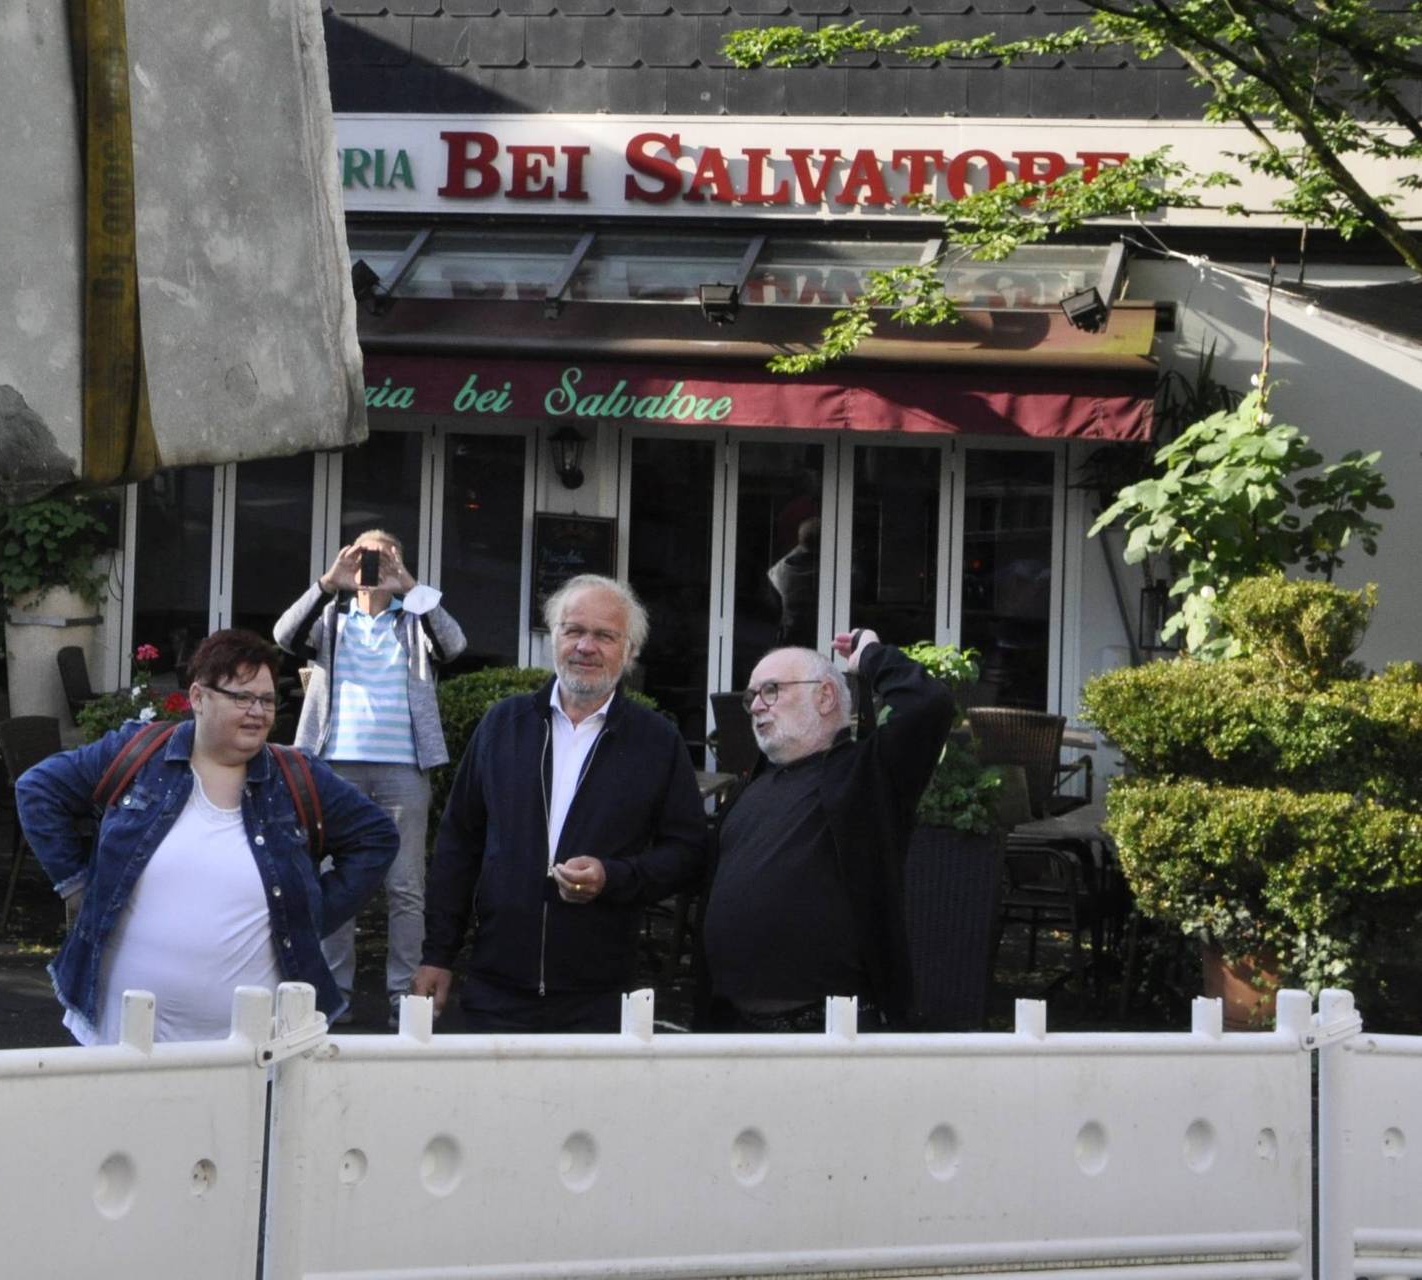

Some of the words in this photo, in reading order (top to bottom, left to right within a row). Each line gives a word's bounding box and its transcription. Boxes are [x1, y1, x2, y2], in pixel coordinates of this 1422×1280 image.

[338, 147, 416, 190] RIA
[438, 131, 591, 200] BEI
[453, 374, 513, 413] bei
[544, 367, 733, 421] Salvatore
